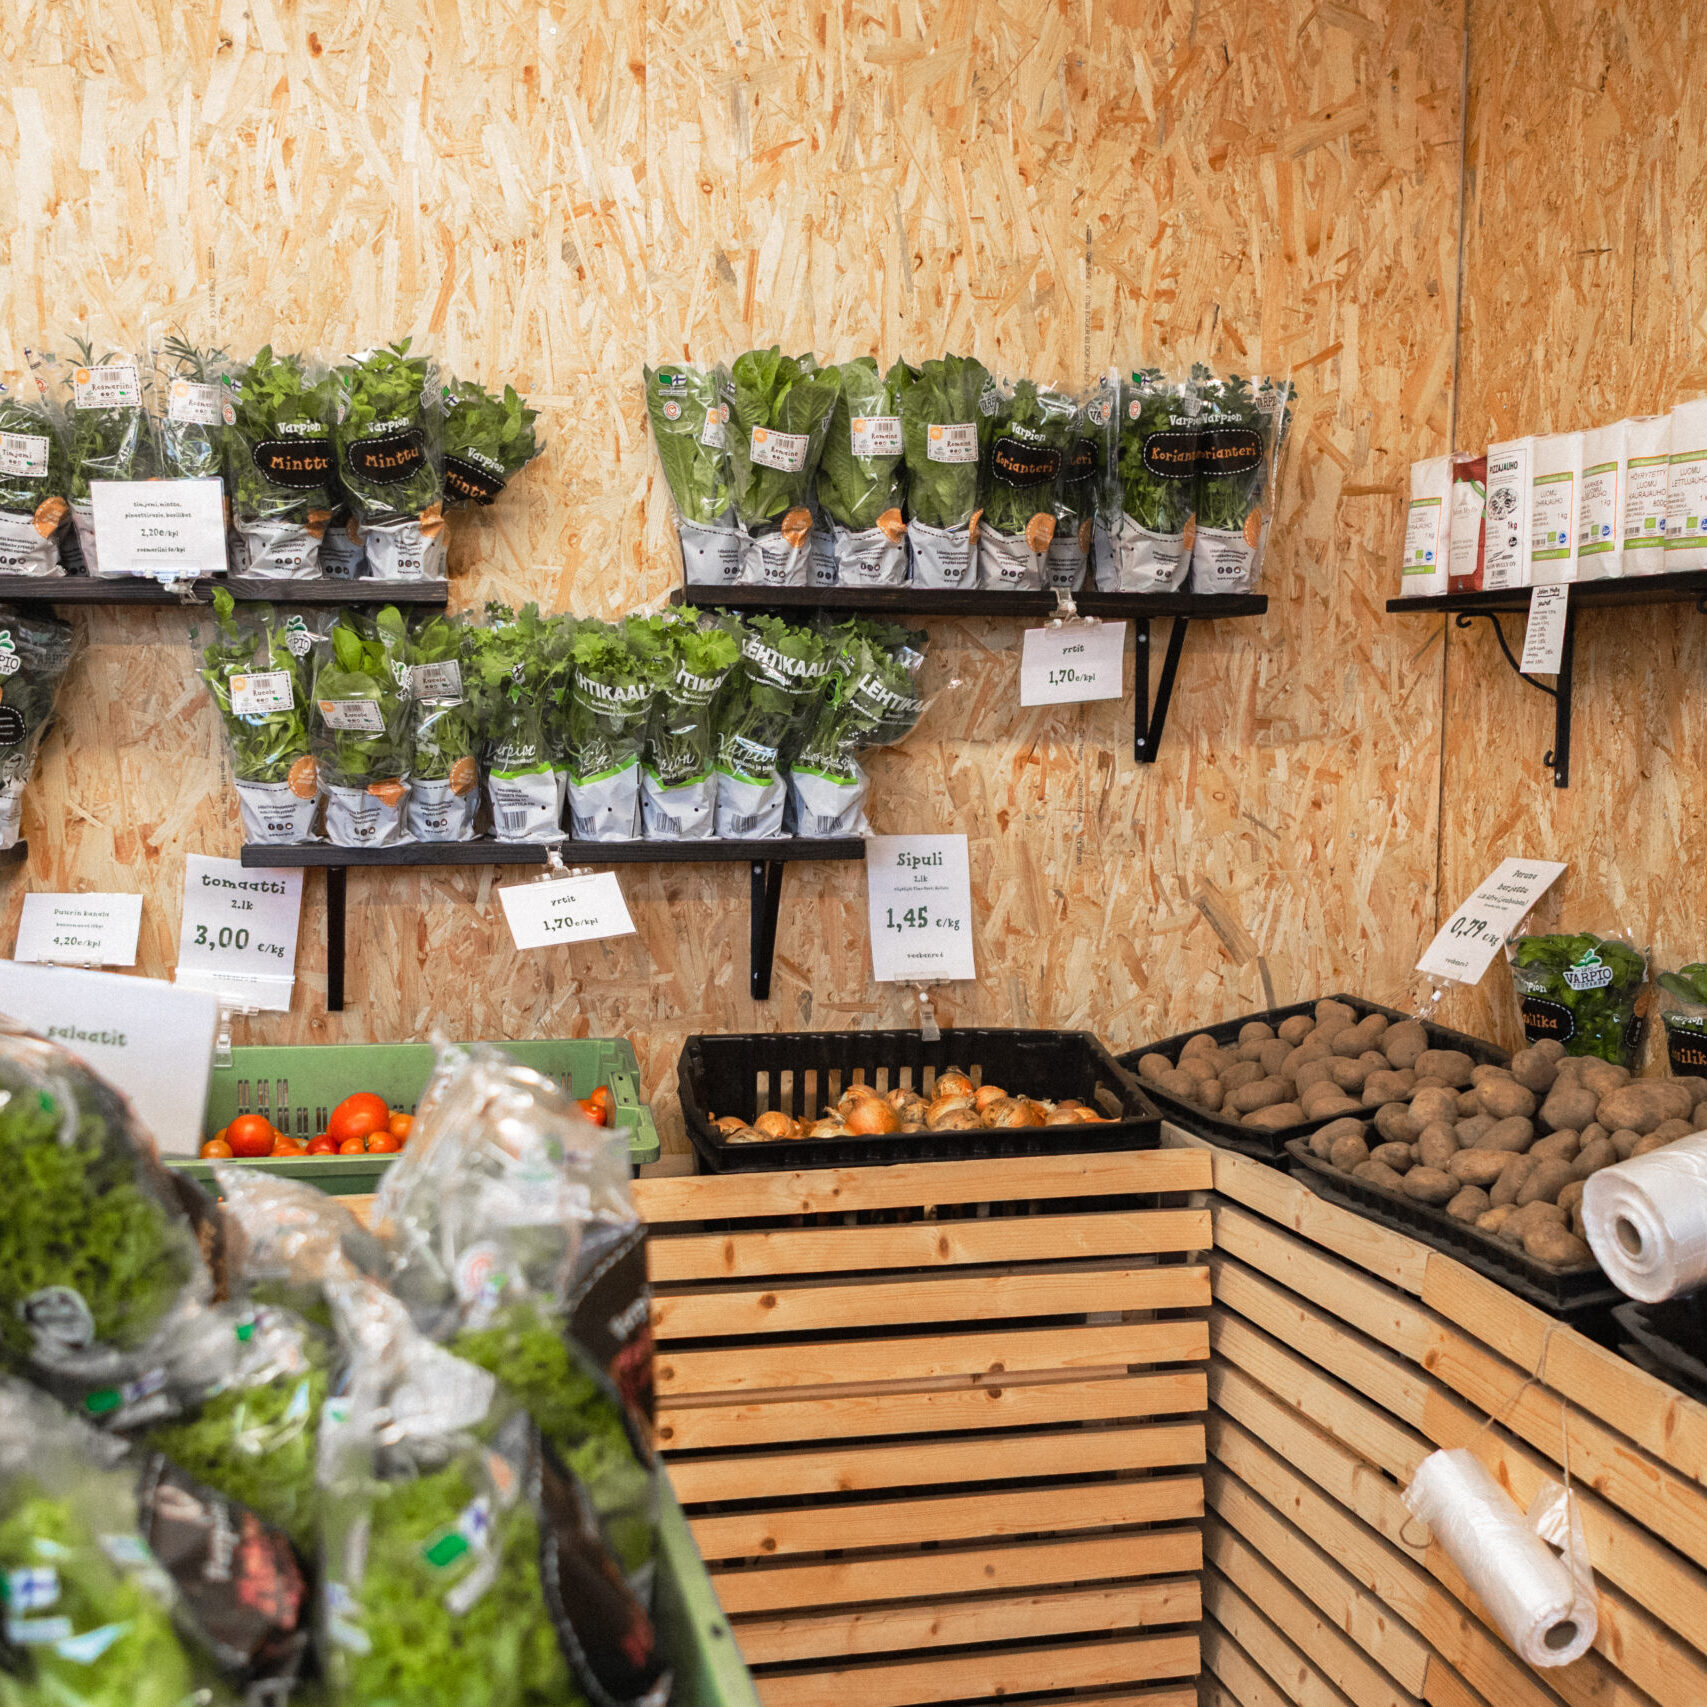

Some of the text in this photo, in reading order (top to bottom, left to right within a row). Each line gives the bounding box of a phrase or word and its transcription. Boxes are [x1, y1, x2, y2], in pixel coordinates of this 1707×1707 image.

[277, 418, 322, 436] Varpion
[367, 415, 410, 434] Varpion
[1202, 410, 1243, 426] Varpion
[1011, 420, 1047, 442] Varpion
[364, 446, 419, 469] Minttu
[466, 446, 505, 474] Varpion
[1489, 461, 1519, 475] PIZZAJAUHO
[1062, 644, 1085, 655] yrtit
[896, 851, 943, 869] Sipuli
[201, 873, 286, 895] tomaatti
[550, 895, 576, 907] yrtit
[886, 905, 960, 933] 1,45 €/kg
[1450, 916, 1488, 939] 0,79
[193, 923, 285, 958] 3,00 €/kg
[1565, 968, 1613, 986] VARPIO
[48, 1024, 127, 1047] salaatit
